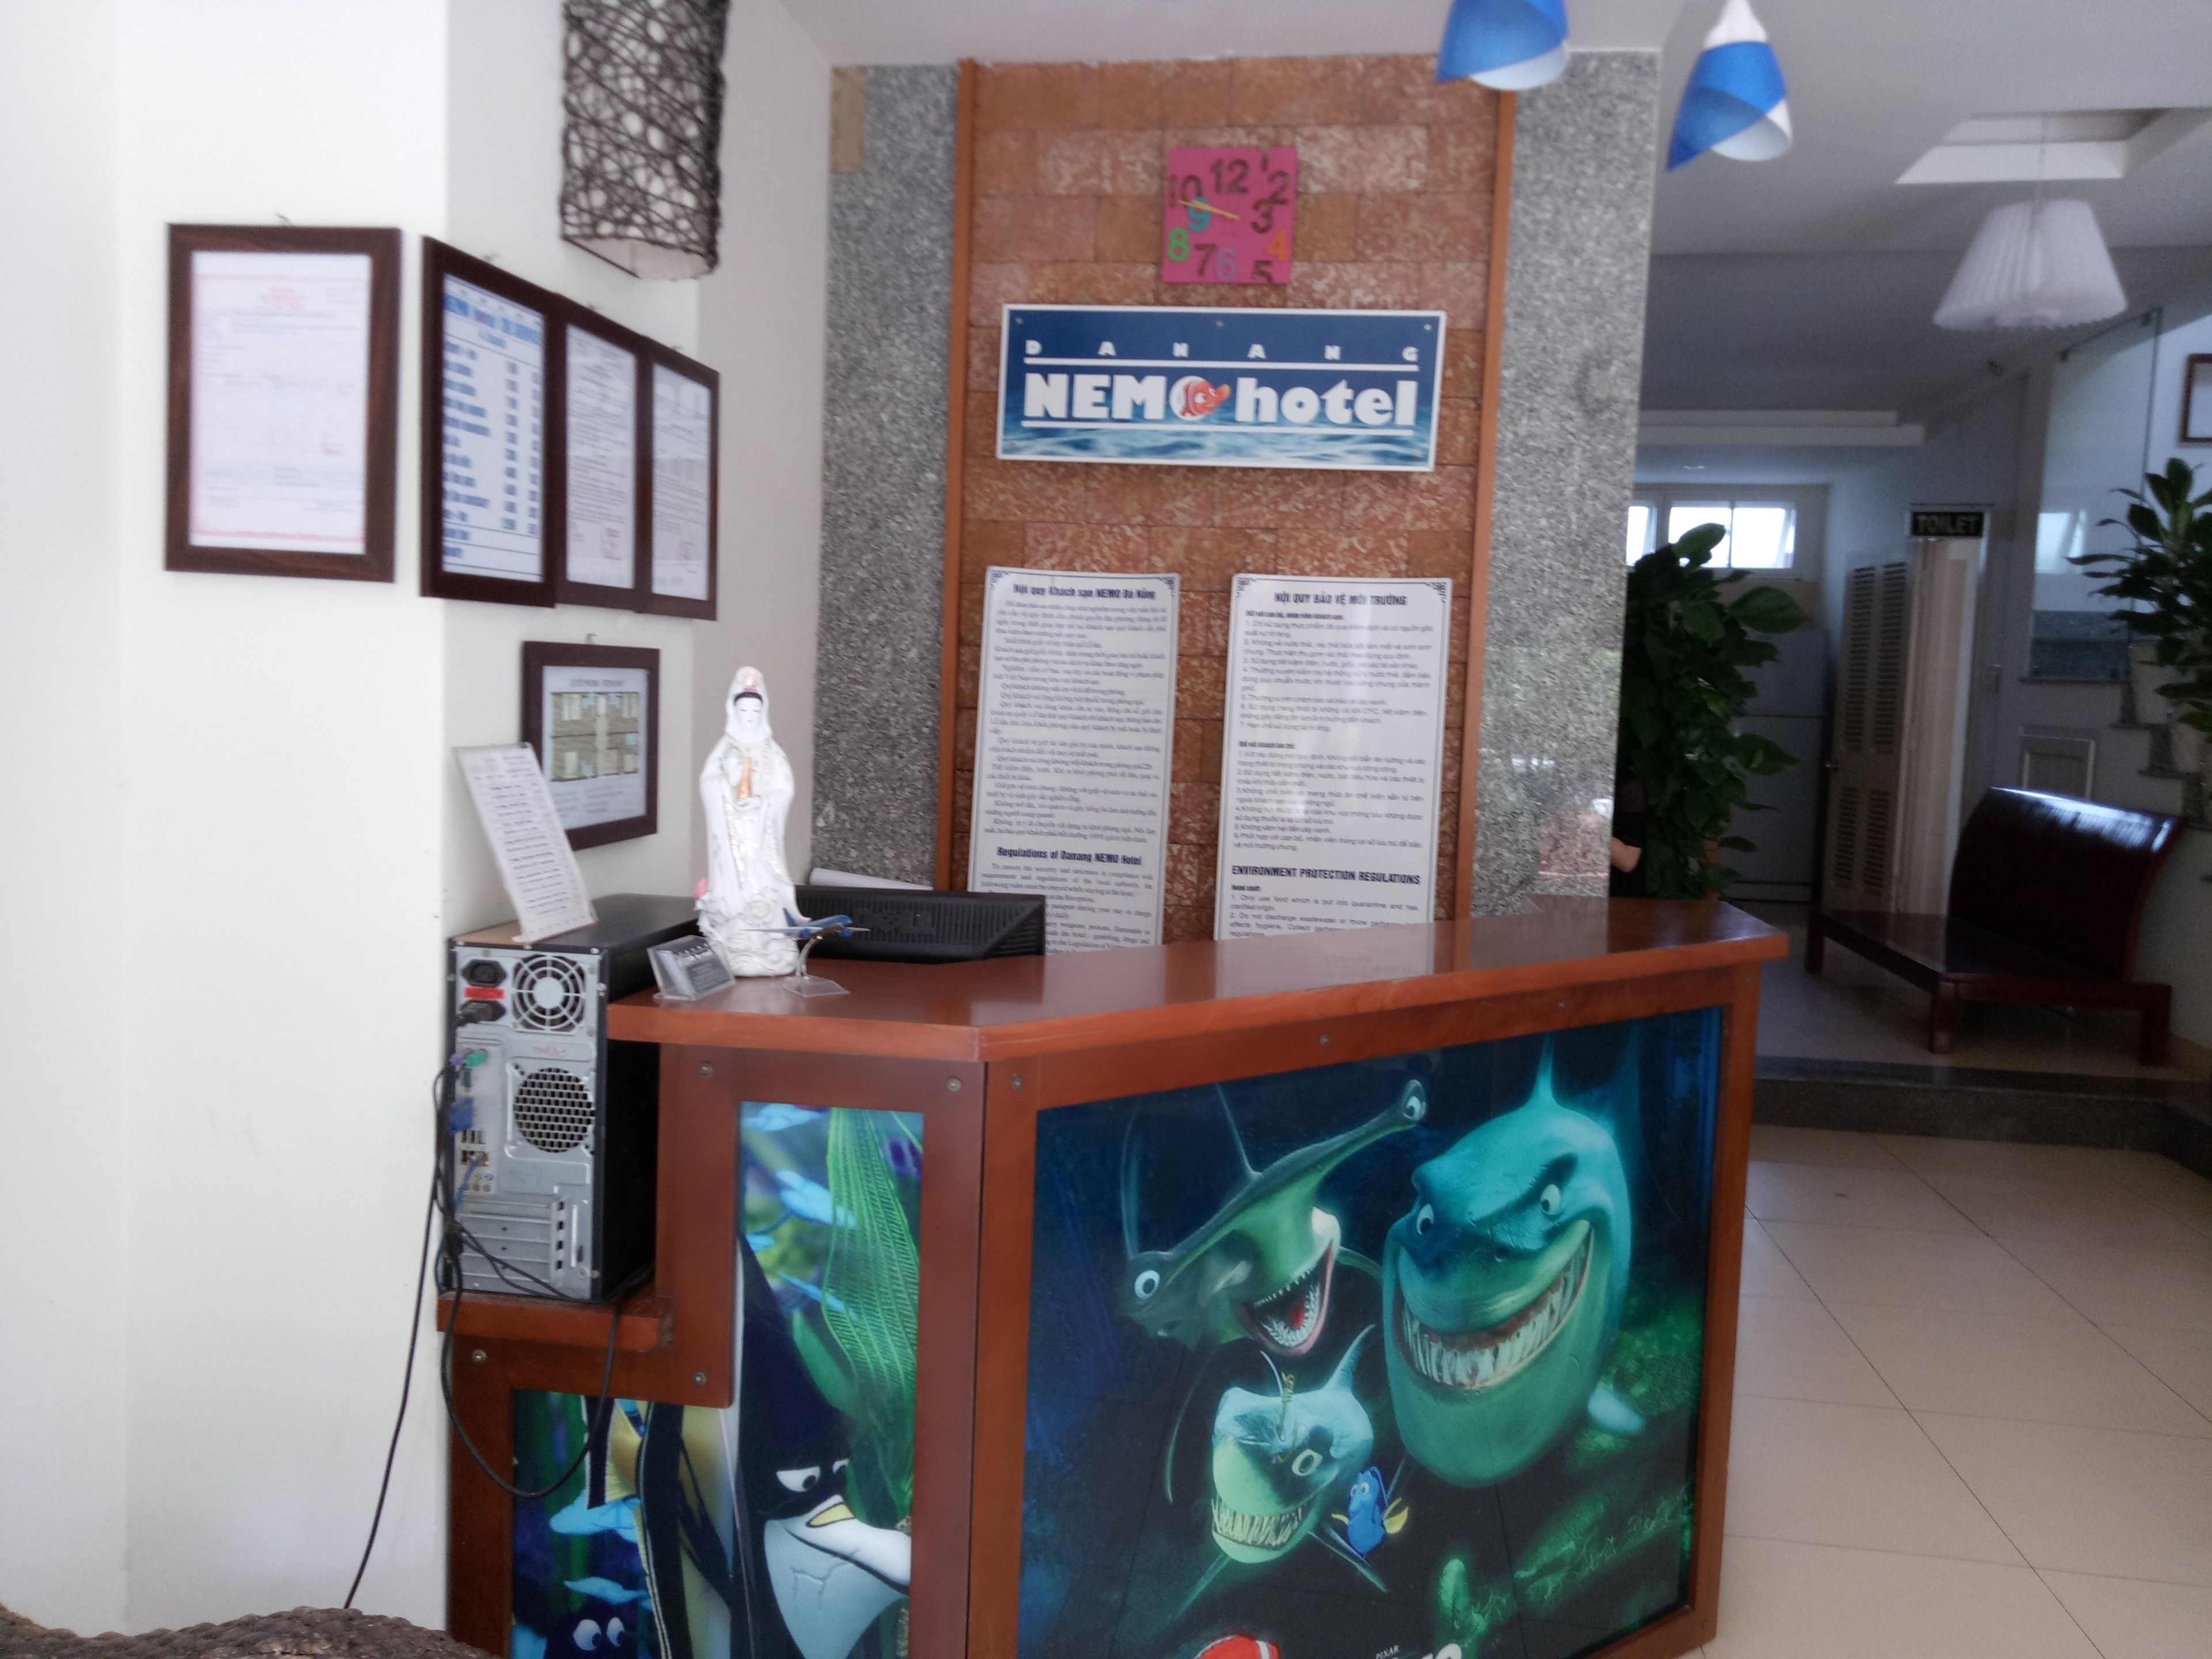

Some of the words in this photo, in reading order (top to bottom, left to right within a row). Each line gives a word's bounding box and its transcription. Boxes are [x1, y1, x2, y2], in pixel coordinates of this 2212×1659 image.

[1168, 175, 1202, 208] 10
[1211, 158, 1248, 194] 12
[1270, 171, 1289, 204] 2
[1188, 195, 1210, 232] 9
[1251, 198, 1272, 234] 3
[1168, 227, 1188, 263] 8
[1195, 243, 1216, 276] 7
[1266, 228, 1290, 262] 4
[1217, 247, 1237, 282] 6
[1252, 260, 1274, 284] 5
[1025, 339, 1418, 362] DANANG
[1025, 373, 1211, 421] NEMO
[1236, 377, 1418, 425] hotel
[1096, 589, 1120, 599] NEMO
[1293, 593, 1309, 604] QUY
[997, 847, 1047, 859] Regulations
[1050, 850, 1058, 859] of
[1060, 851, 1092, 862] Danang
[1094, 853, 1119, 863] NEMO
[1121, 854, 1142, 865] Hotel
[1232, 865, 1297, 877] ENVIRONMENT
[1300, 868, 1355, 880] PROTECTION
[1358, 872, 1421, 884] REGULATIONS
